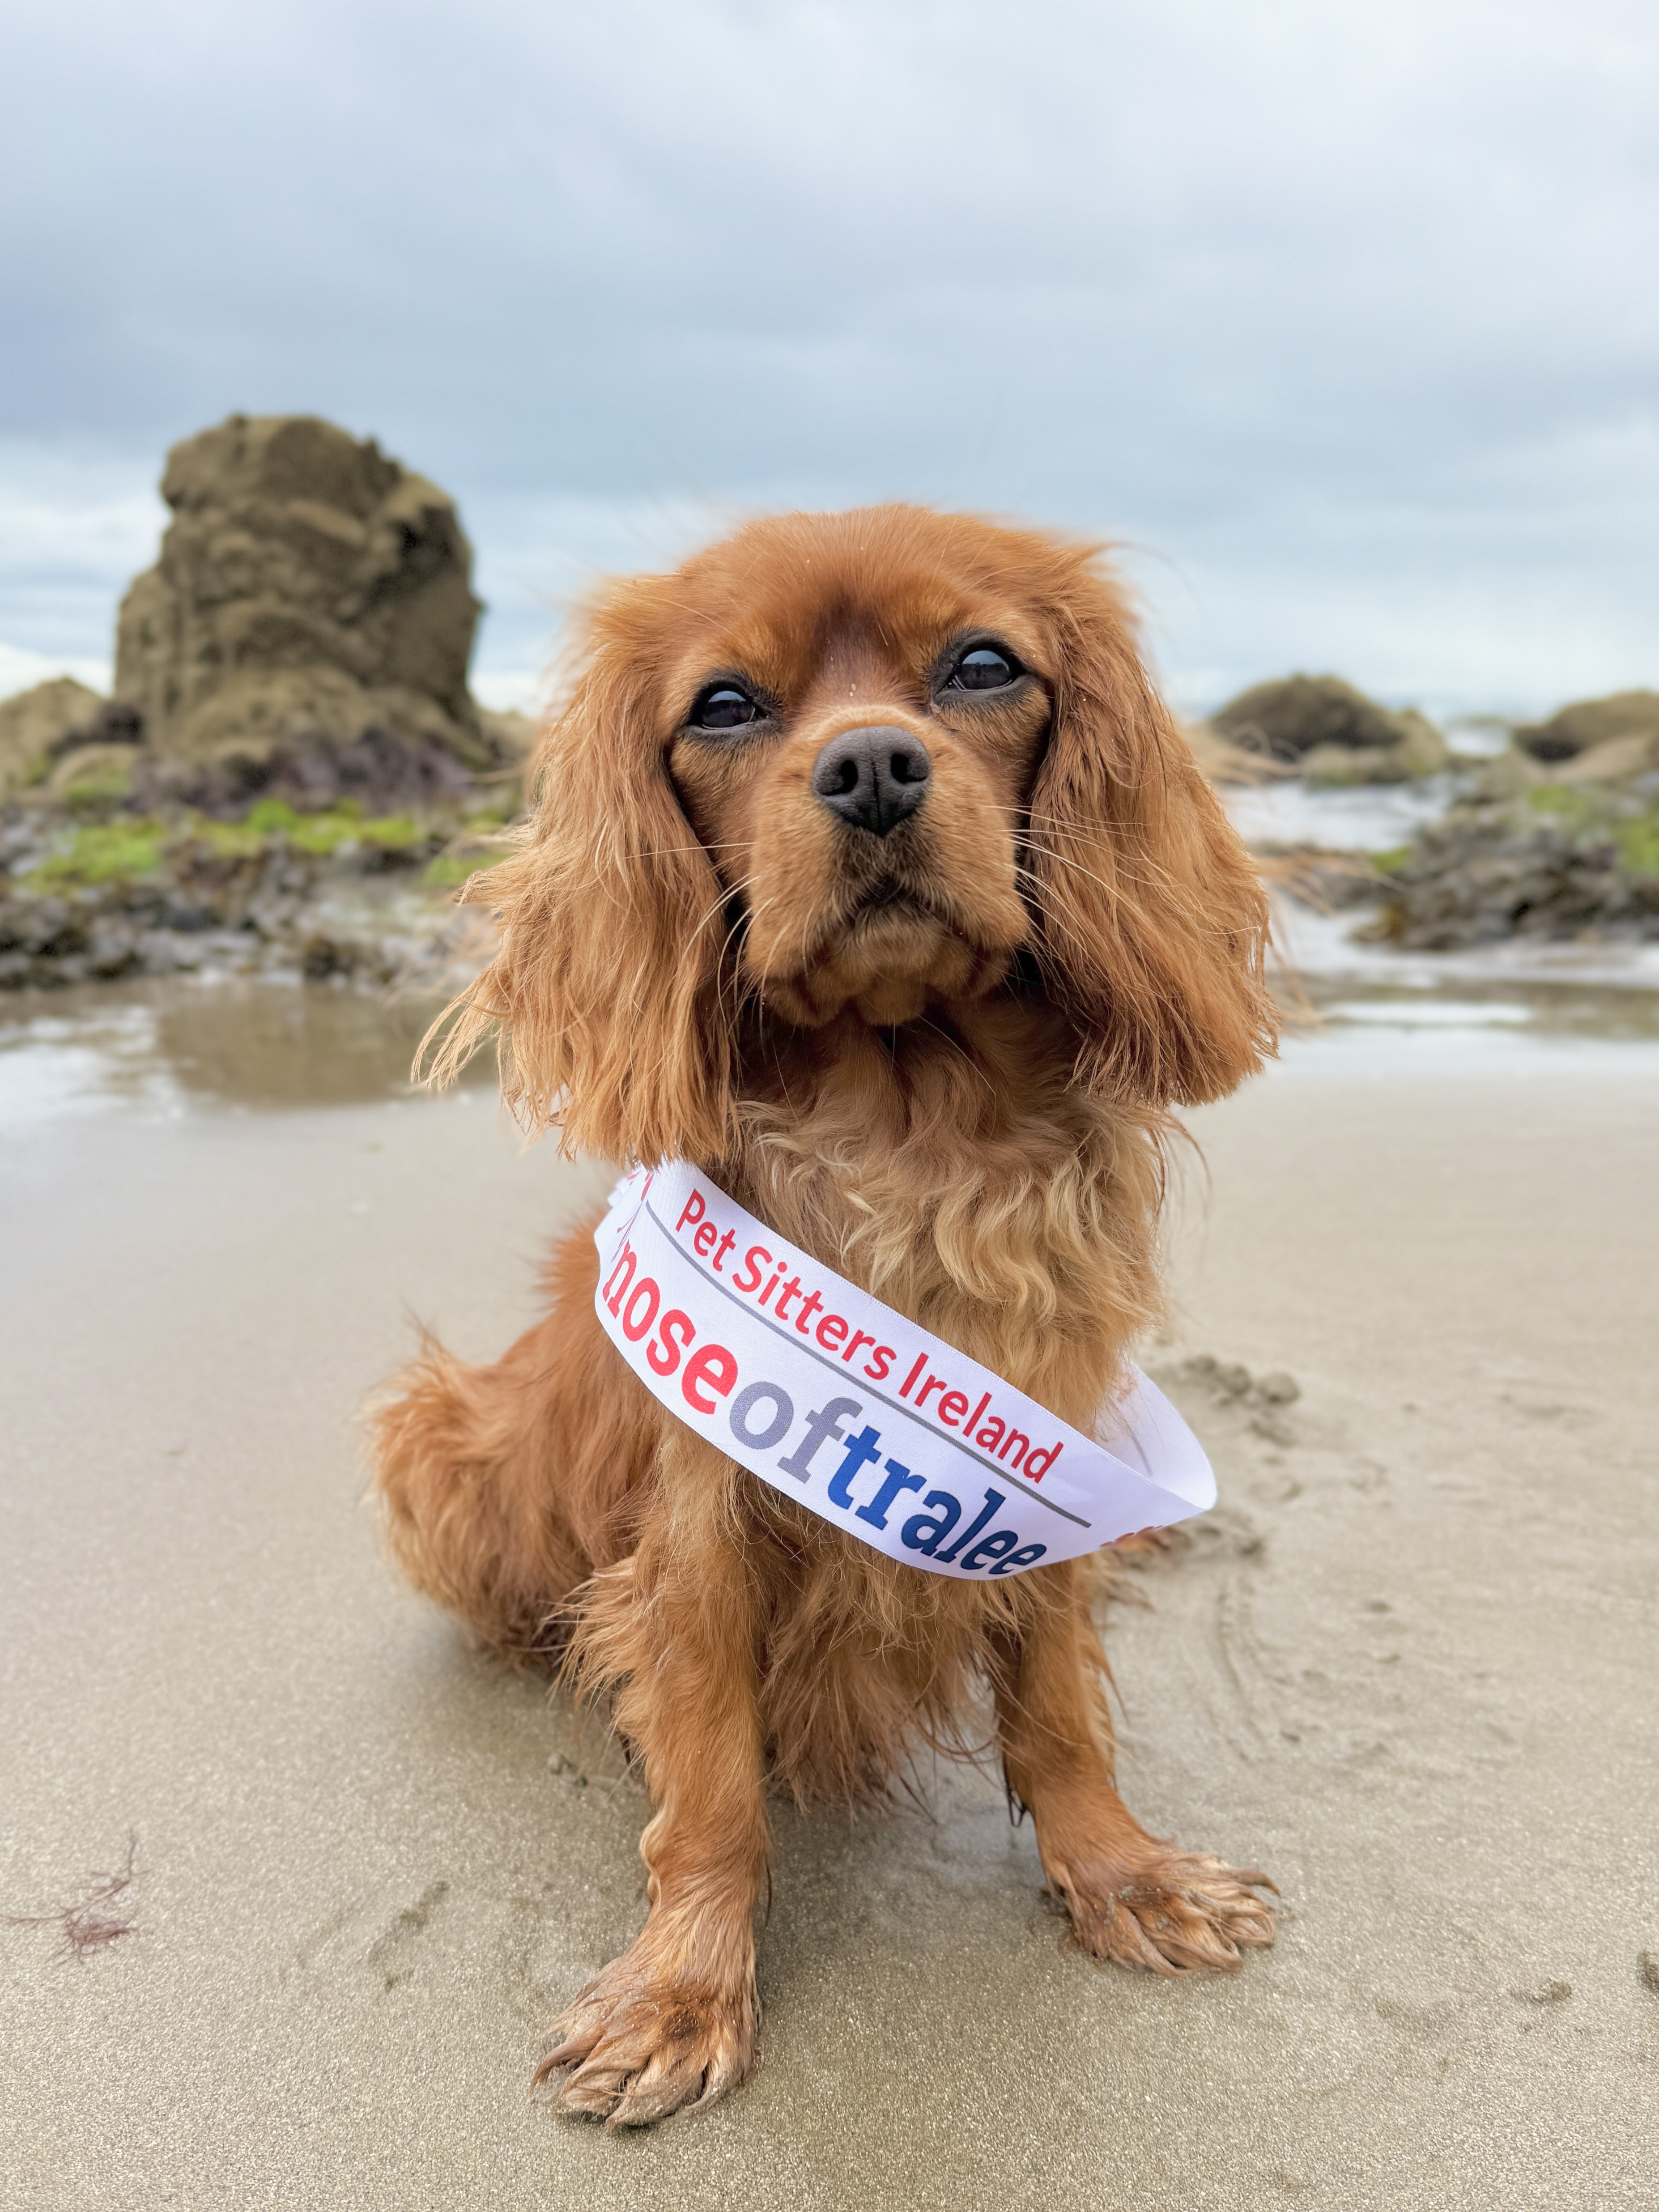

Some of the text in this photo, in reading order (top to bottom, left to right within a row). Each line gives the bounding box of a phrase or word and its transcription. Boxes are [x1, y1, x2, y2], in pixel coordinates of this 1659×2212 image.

[675, 1188, 736, 1272] Pet
[732, 1246, 897, 1380] Sitters
[898, 1353, 1064, 1484] Ireland
